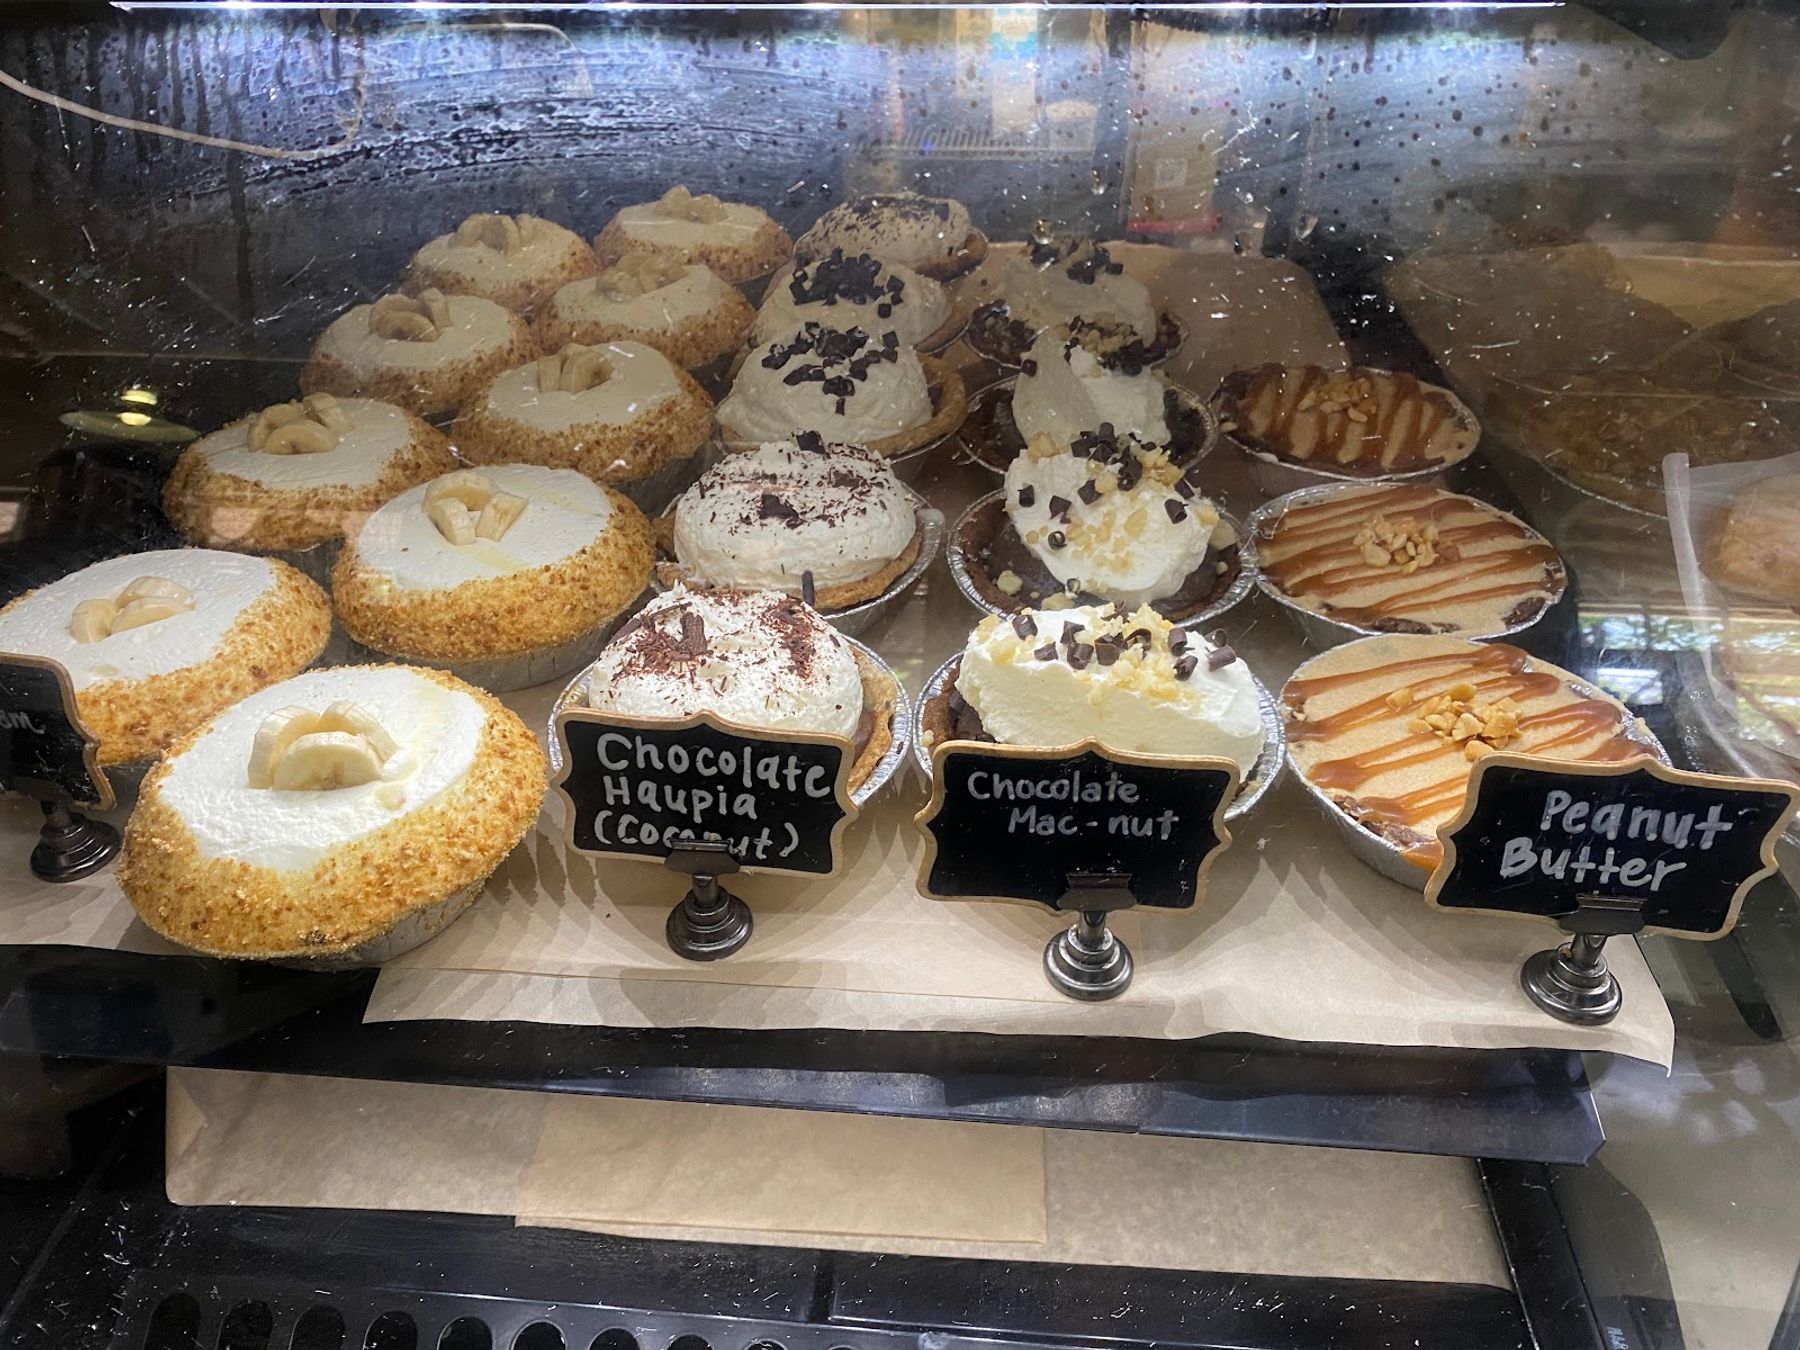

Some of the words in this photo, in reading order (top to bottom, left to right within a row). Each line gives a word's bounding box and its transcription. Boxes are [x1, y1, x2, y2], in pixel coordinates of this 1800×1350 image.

[597, 732, 831, 798] Chocolate
[967, 770, 1140, 804] Chocolate
[603, 775, 758, 824] Haupia
[1539, 789, 1735, 851] Peanut
[1499, 836, 1688, 892] Butter
